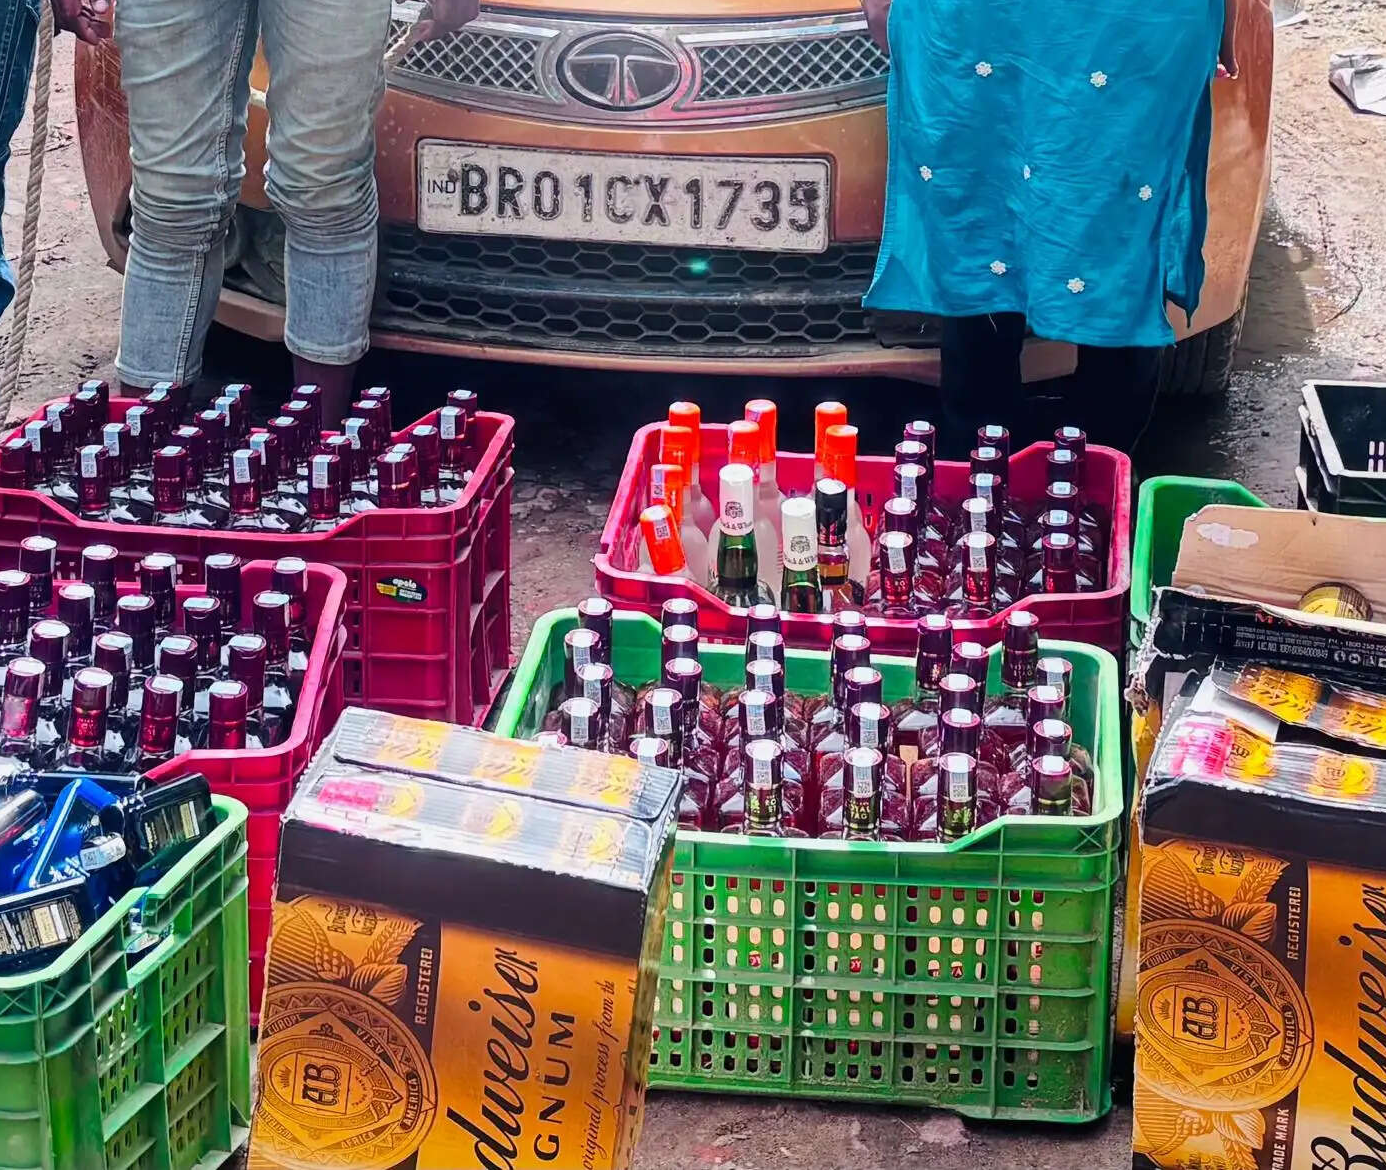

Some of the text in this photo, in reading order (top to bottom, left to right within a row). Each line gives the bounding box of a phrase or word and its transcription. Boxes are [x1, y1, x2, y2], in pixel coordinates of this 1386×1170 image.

[426, 178, 457, 195] IND
[1230, 964, 1258, 993] ASIA
[592, 993, 619, 1043] from
[356, 1028, 383, 1056] ASIA
[1282, 1010, 1296, 1063] AMERICA
[591, 1042, 611, 1106] process
[1222, 1068, 1256, 1086] AFRICA
[404, 1077, 420, 1128] AMERICA
[1279, 1108, 1289, 1141] MARK
[340, 1131, 376, 1150] AFRICA
